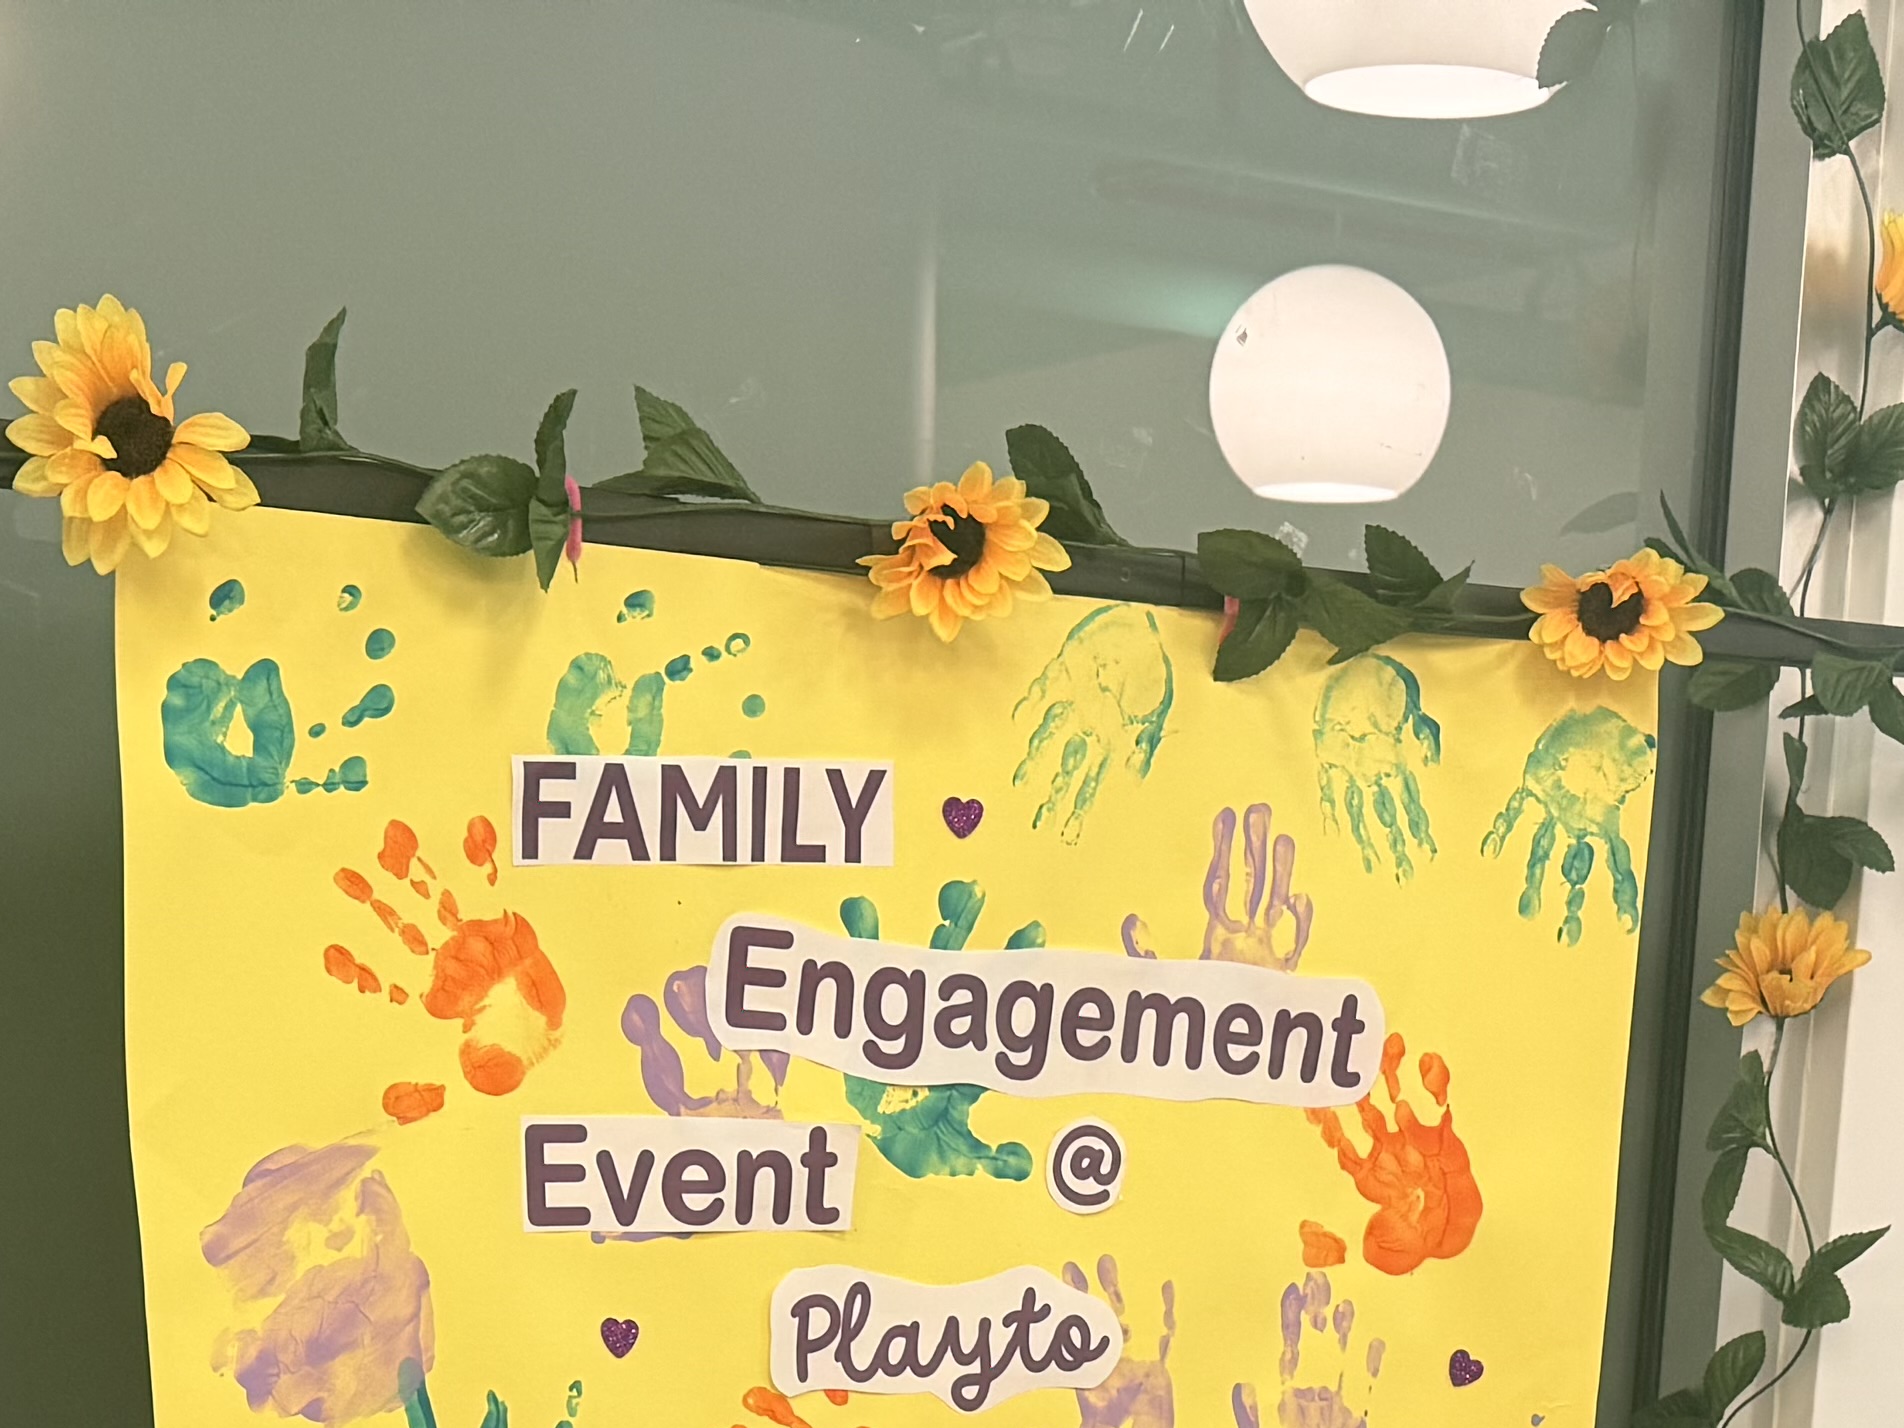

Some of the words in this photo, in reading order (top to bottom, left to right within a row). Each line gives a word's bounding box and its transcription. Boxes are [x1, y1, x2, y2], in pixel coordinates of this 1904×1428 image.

[516, 760, 888, 866] FAMILY
[722, 923, 1366, 1090] Engagement
[522, 1123, 842, 1229] Event
[1052, 1124, 1123, 1206] @
[789, 1280, 1112, 1410] Playto
